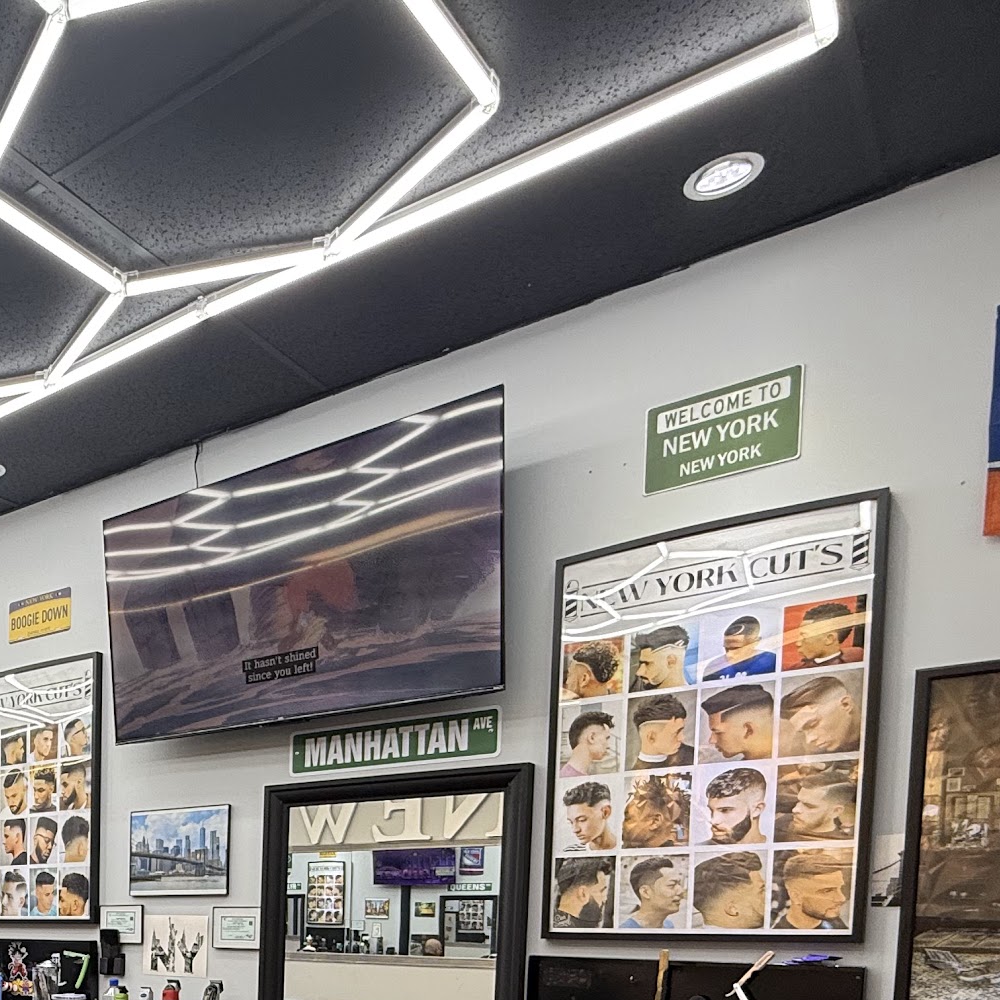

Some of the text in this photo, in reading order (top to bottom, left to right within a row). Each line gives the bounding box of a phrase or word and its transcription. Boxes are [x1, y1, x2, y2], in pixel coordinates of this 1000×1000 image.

[664, 382, 782, 429] WELCOME TO
[662, 408, 779, 458] NEW YORK
[679, 443, 762, 478] NEW YORK
[655, 562, 738, 597] YORK
[749, 542, 844, 579] CUT'S
[10, 604, 68, 631] BOOGIE DOWN
[244, 648, 316, 671] It hasn't shined
[248, 661, 313, 683] since you left!
[304, 716, 493, 768] MANHATTAN AVE
[450, 883, 486, 891] QUEENS
